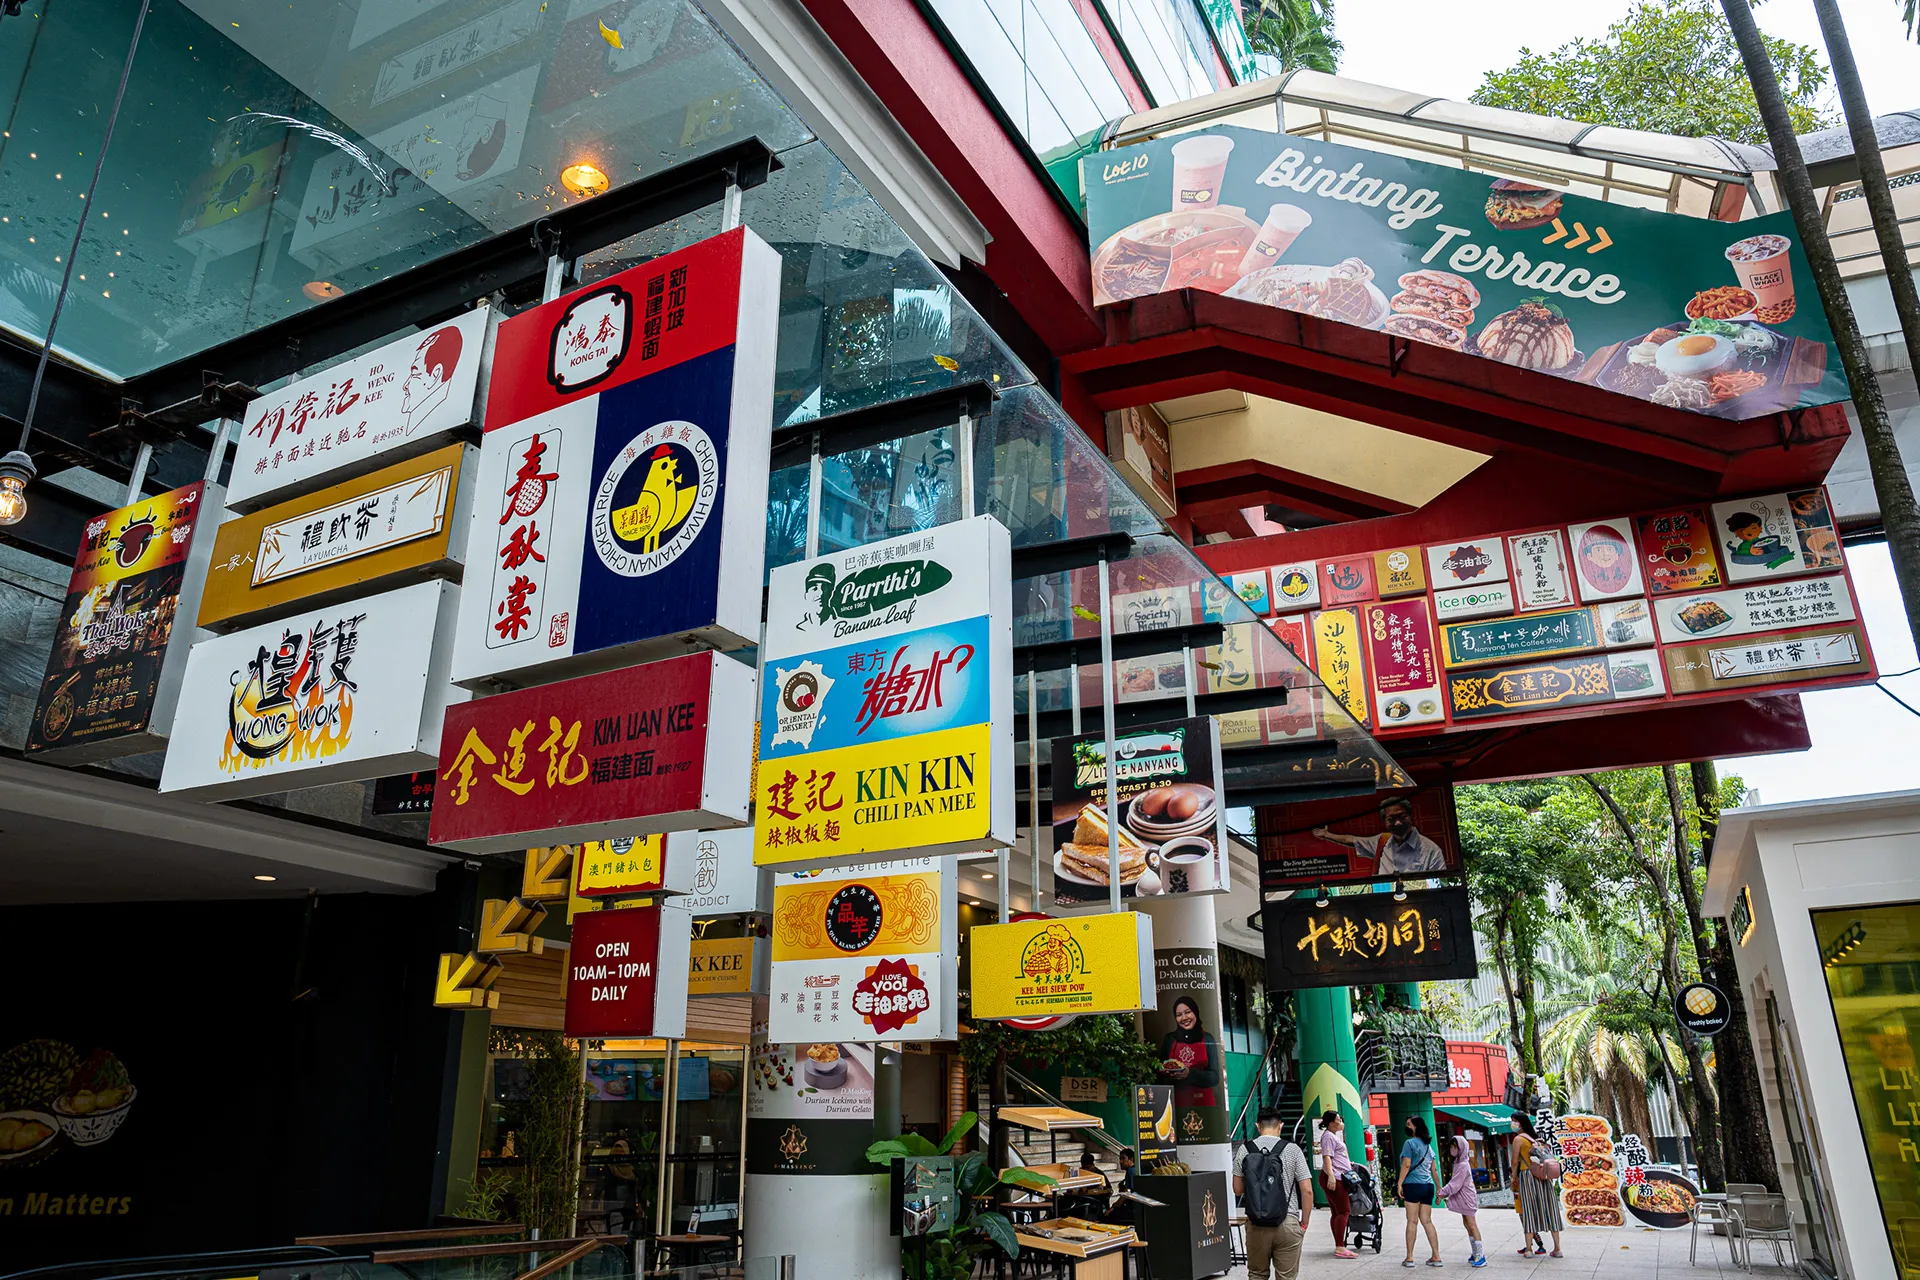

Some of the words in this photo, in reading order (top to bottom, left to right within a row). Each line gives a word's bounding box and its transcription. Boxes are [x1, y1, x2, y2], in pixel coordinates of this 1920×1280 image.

[1255, 147, 1444, 230] Bintang
[1420, 224, 1626, 304] Terrace
[1754, 273, 1778, 281] BLACK
[1755, 277, 1780, 286] WHALE
[665, 264, 688, 332] 新加坡
[570, 352, 594, 367] KONG
[595, 346, 609, 360] TAI
[367, 372, 395, 390] WENG
[369, 364, 384, 377] HO
[364, 389, 383, 404] KEE
[695, 439, 714, 498] CHONG
[597, 470, 619, 510] RICE
[300, 497, 379, 552] 禮飲茶
[682, 503, 710, 541] HWA
[595, 513, 628, 571] CHICKEN
[214, 551, 254, 572] 一家人
[303, 544, 348, 565] LAYUMCHA
[629, 540, 682, 573] HAINAN
[840, 567, 921, 603] Parrthi's
[840, 603, 853, 613] since
[854, 601, 866, 610] 1987
[1438, 596, 1459, 609] ice
[83, 622, 112, 641] Thai
[115, 610, 144, 633] Wok
[834, 617, 883, 638] Banana
[882, 599, 918, 626] Leaf
[1135, 610, 1170, 621] Society
[1474, 644, 1505, 653] Nanyang
[1546, 637, 1564, 645] Shop
[846, 649, 887, 676] 東方
[855, 644, 975, 737] 糖水
[1499, 673, 1560, 694] 金蓮記
[1503, 693, 1521, 702] Kim
[1523, 691, 1540, 700] Lian
[1543, 689, 1558, 697] Kee
[235, 714, 287, 744] WONG
[298, 701, 341, 731] WOK
[592, 716, 621, 747] KIM
[627, 709, 662, 741] LIAN
[666, 702, 695, 735] KEE
[782, 720, 813, 733] DESSERT
[1222, 719, 1247, 727] ROAST
[591, 750, 655, 785] 福建面
[1130, 757, 1178, 774] NANYANG
[854, 763, 910, 803] KIN
[918, 752, 976, 795] KIN
[1150, 780, 1172, 789] 8.30
[766, 769, 844, 821] 建記
[853, 804, 898, 826] CHILI
[903, 798, 934, 818] PAN
[939, 792, 977, 813] MEE
[682, 895, 730, 908] TEADDICT
[595, 942, 630, 958] OPEN
[1173, 954, 1213, 966] Cendol!
[708, 954, 743, 971] KEE
[885, 973, 901, 981] LOVE
[1190, 981, 1215, 989] Cendol
[591, 985, 627, 1001] DAILY
[781, 993, 788, 1003] 粥
[1050, 985, 1067, 993] SIEW
[814, 991, 822, 1023] 豆腐花
[855, 988, 929, 1016] 老油鬼鬼
[1071, 1079, 1098, 1090] DSR
[23, 1193, 131, 1215] Matters
